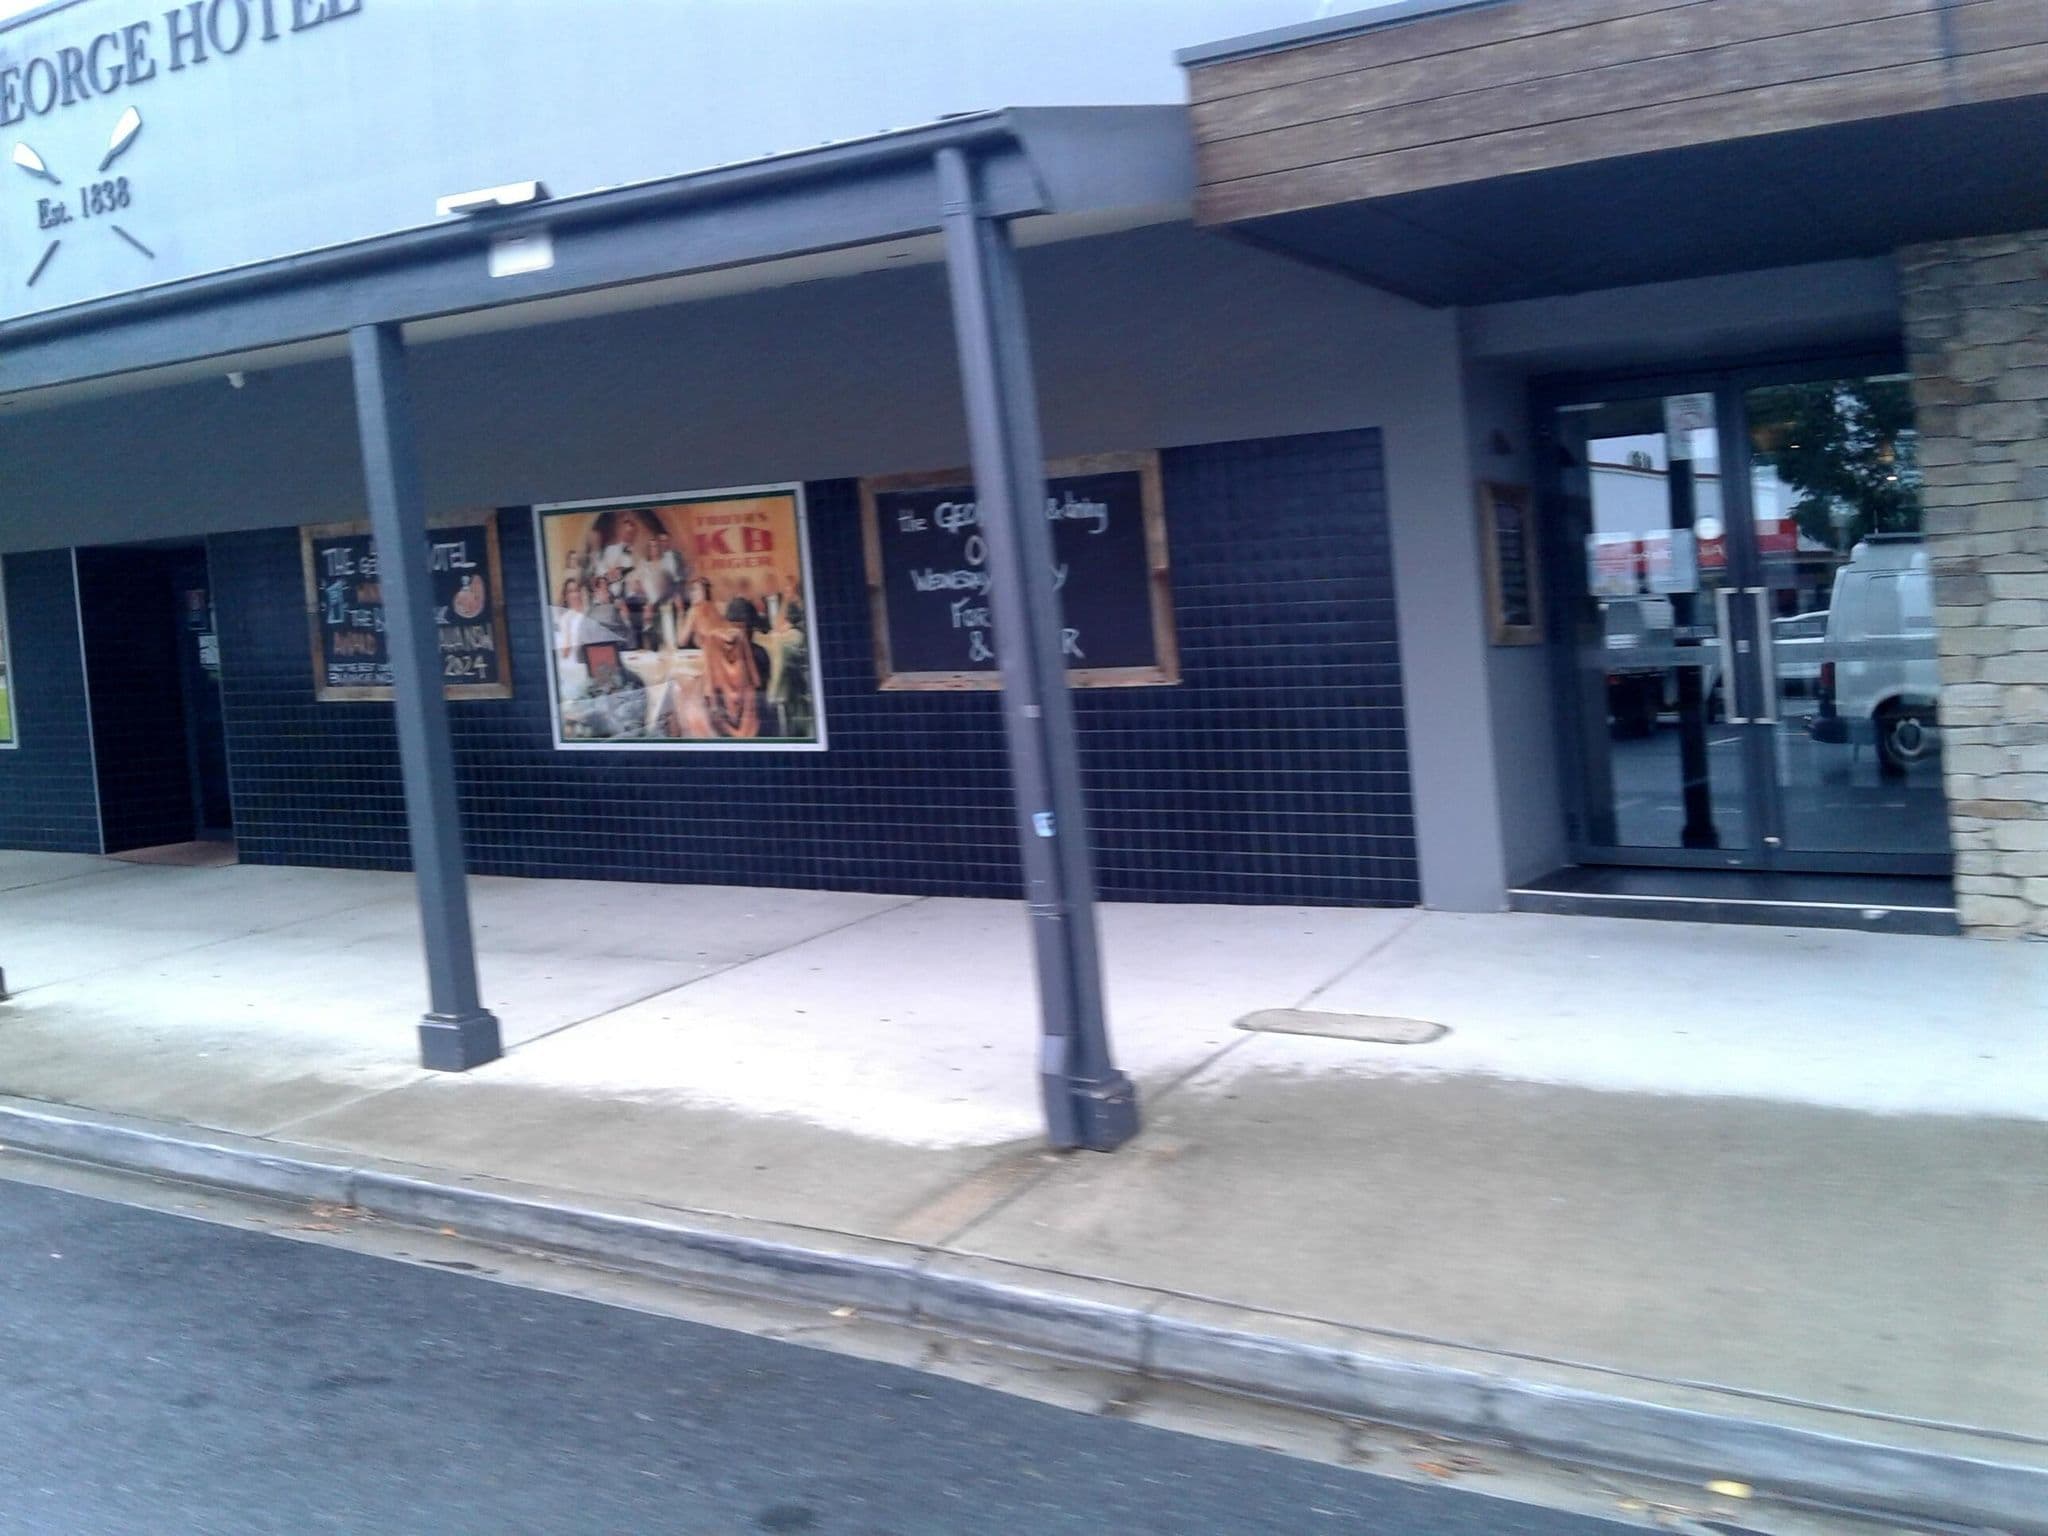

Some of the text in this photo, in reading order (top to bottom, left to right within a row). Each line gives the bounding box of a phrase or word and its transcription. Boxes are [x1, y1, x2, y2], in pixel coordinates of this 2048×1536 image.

[0, 20, 157, 127] EORGE
[36, 176, 132, 230] Est. 1838
[425, 540, 478, 574] OTEL
[694, 525, 774, 556] KB
[443, 654, 489, 680] 2024
